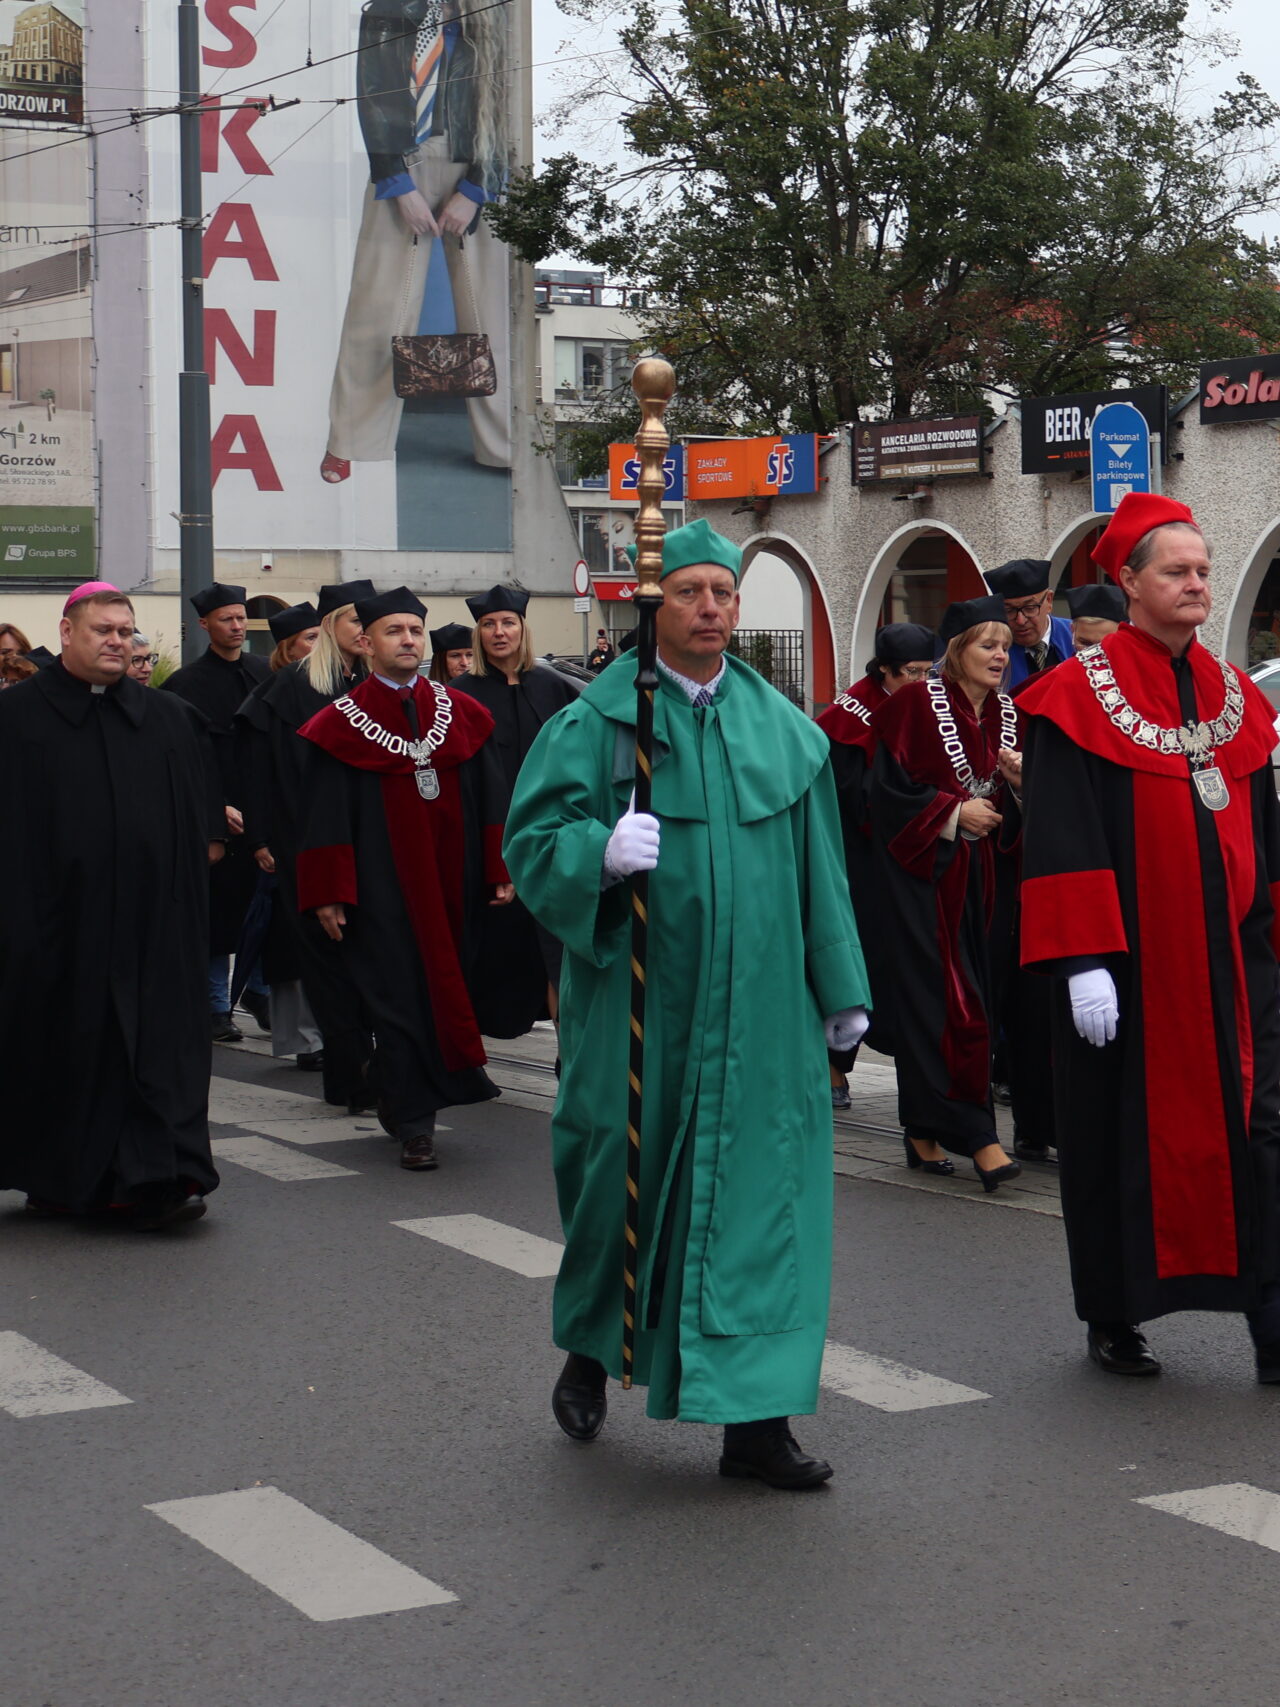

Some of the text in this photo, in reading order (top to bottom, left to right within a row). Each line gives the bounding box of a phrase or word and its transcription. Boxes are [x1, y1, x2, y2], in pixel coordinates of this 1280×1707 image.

[0, 93, 69, 115] ORZOW.PL
[1045, 406, 1081, 443] BEER
[29, 433, 61, 445] 2 km
[881, 429, 977, 447] KANCELARIA ROZWODOWA
[1099, 432, 1140, 441] Parkomat
[0, 454, 56, 466] Gorzów
[766, 443, 794, 486] STS
[1108, 460, 1133, 470] Bilety
[620, 449, 676, 490] SS
[697, 472, 733, 483] SPORTOWE
[1096, 471, 1145, 481] parkingowe
[1, 524, 80, 534] www.gbsbank.pl
[28, 549, 77, 558] Grupa BPS
